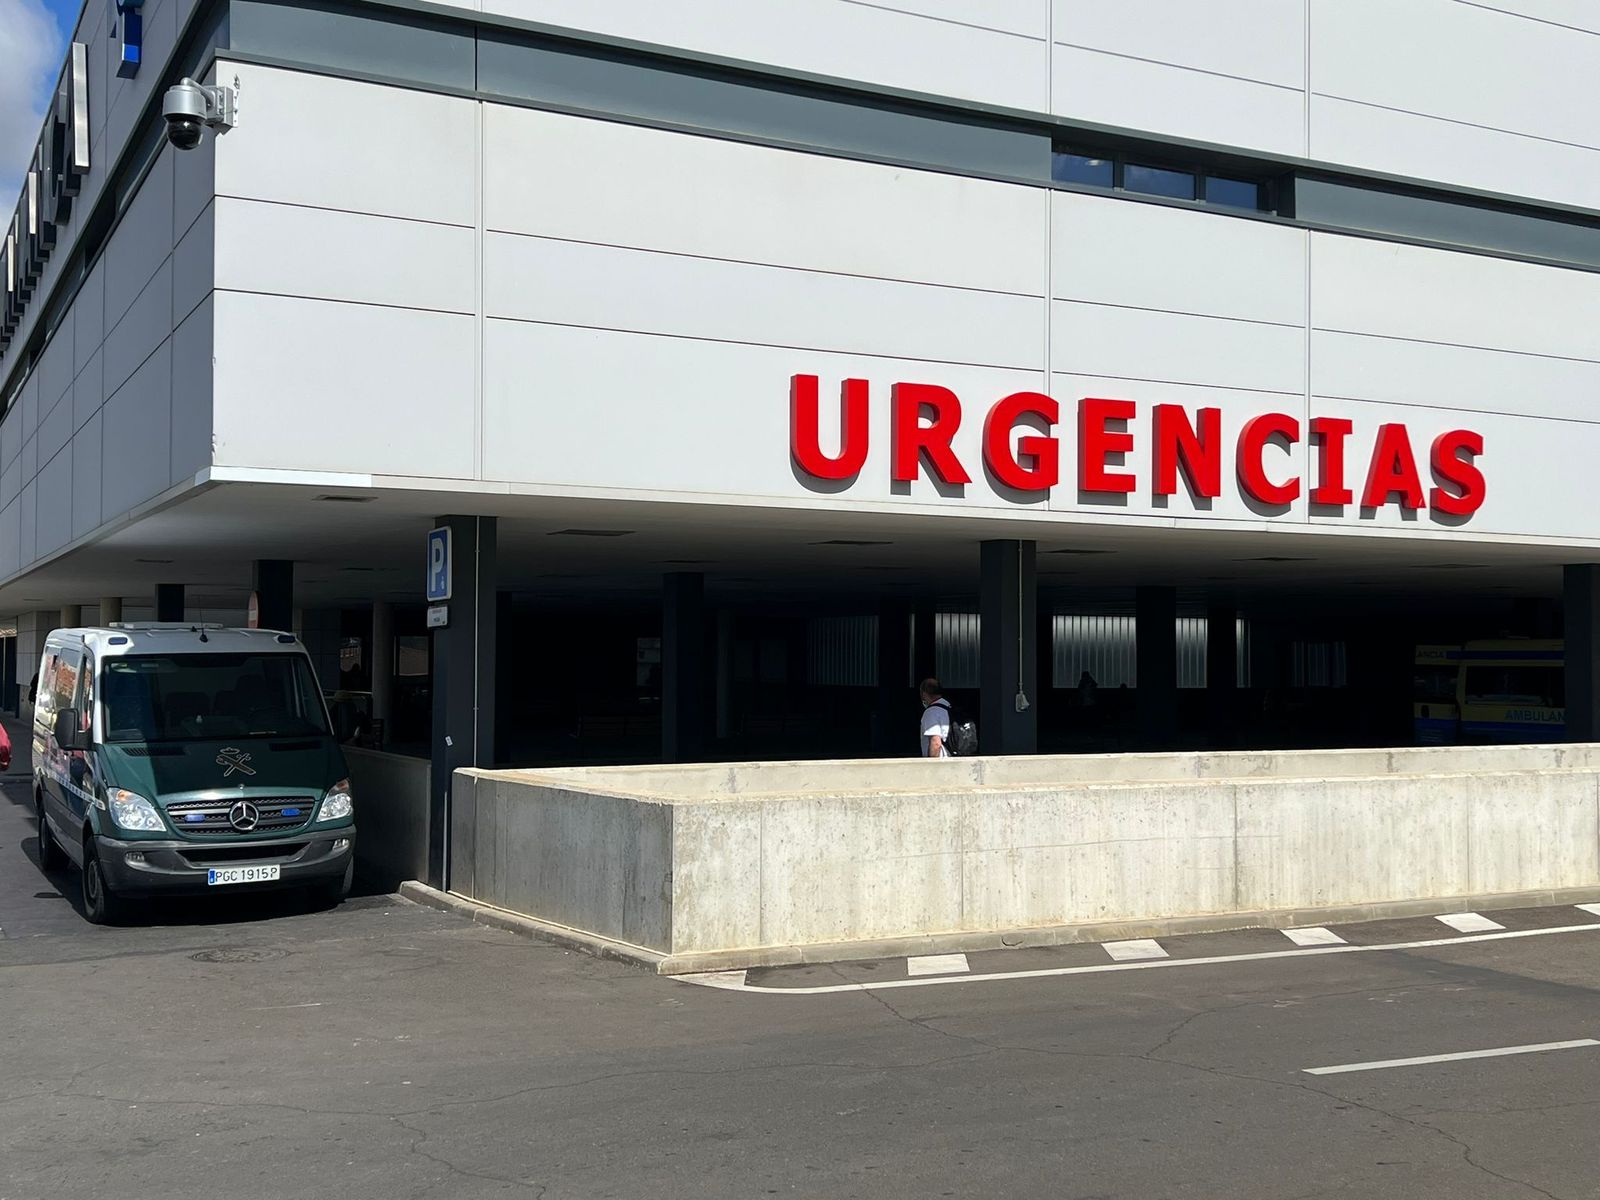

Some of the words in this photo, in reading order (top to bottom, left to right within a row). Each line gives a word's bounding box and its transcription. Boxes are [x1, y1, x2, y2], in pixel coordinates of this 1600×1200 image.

[789, 373, 1486, 518] URGENCIAS
[431, 537, 445, 592] P
[215, 870, 238, 883] PGC
[241, 867, 278, 881] 1915P
